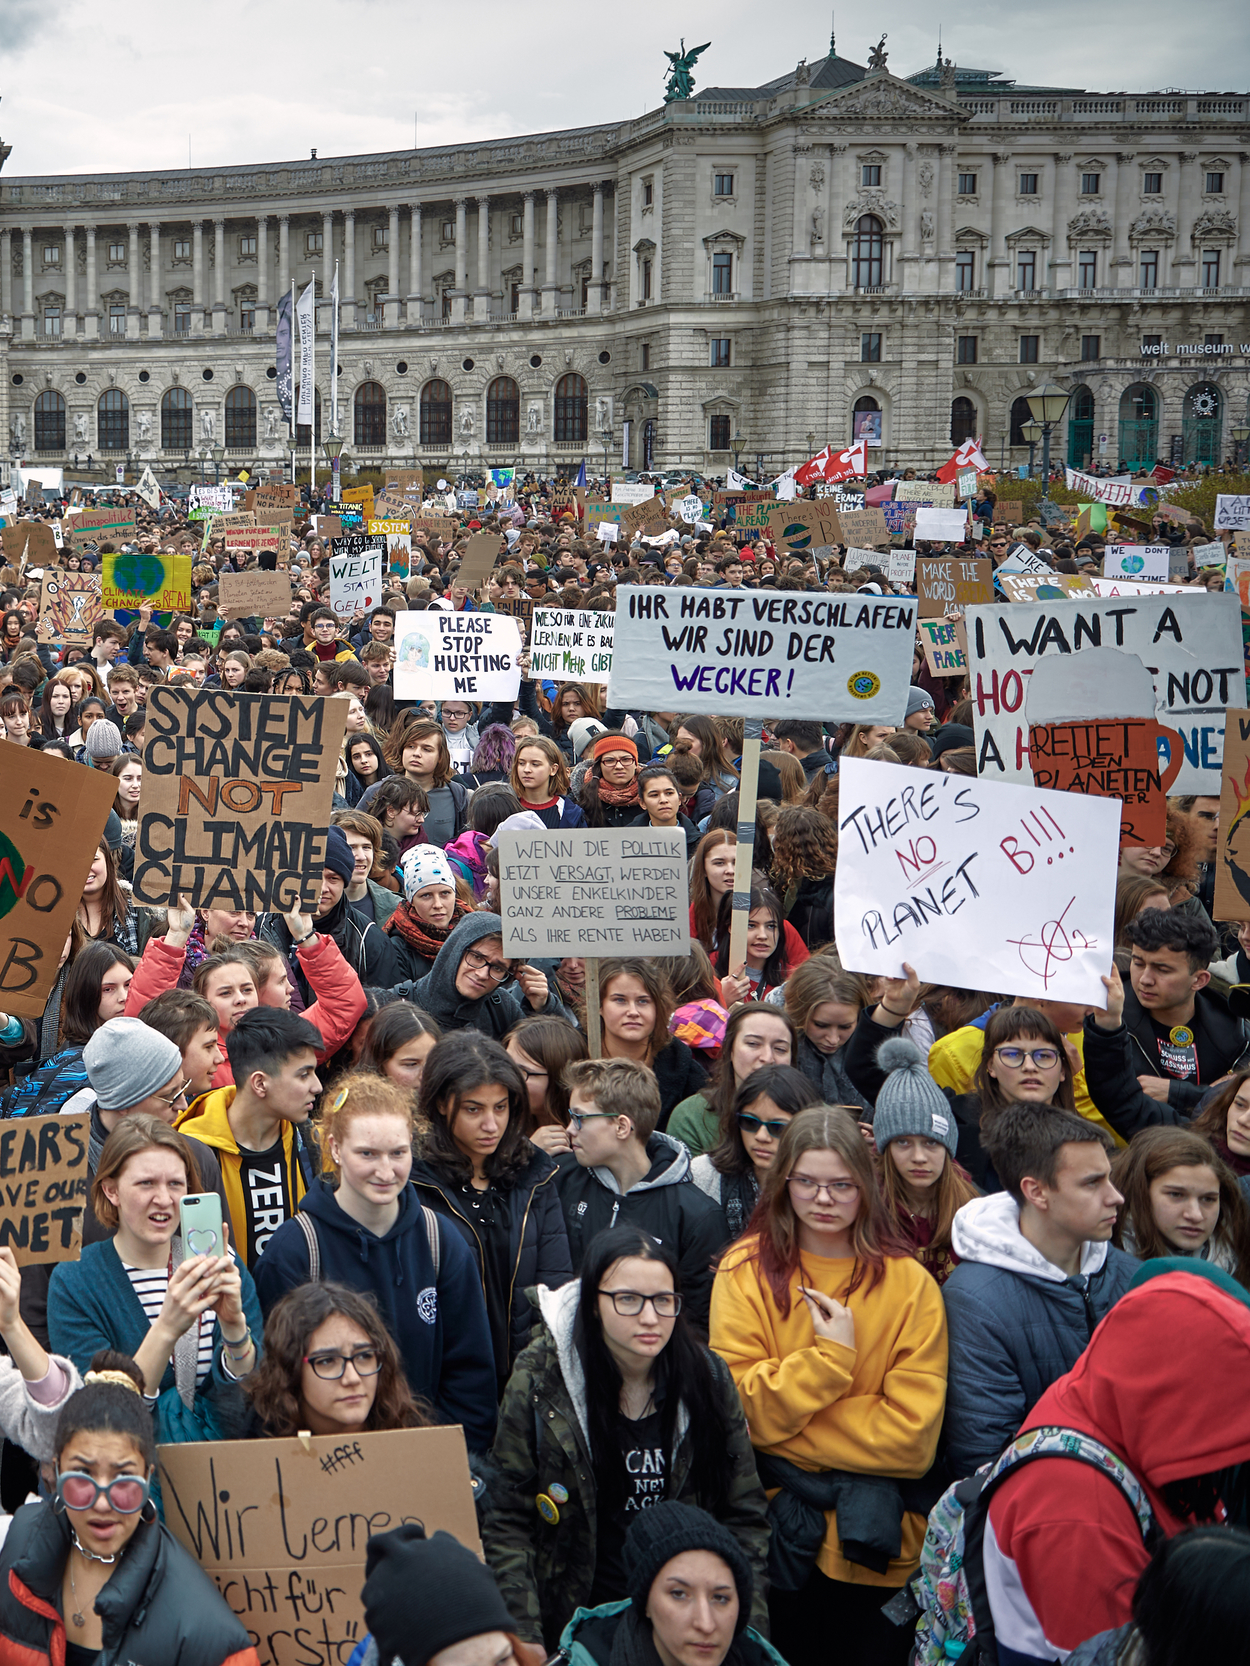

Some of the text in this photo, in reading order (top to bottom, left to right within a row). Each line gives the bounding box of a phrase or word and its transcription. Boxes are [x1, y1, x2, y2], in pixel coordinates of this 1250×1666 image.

[1140, 341, 1169, 354] welt
[1176, 344, 1233, 353] museum
[817, 485, 843, 493] KEINE
[1095, 481, 1133, 503] WITH
[339, 503, 363, 511] TITANIC
[737, 504, 754, 515] THE
[777, 502, 830, 523] There's NO
[71, 509, 133, 530] Klimapolitik?
[370, 521, 409, 533] SYSTEM
[334, 537, 352, 546] WHY
[737, 529, 760, 540] THAN
[818, 521, 835, 544] B
[892, 553, 914, 562] PLANET
[1015, 546, 1043, 573] LIKE
[1111, 546, 1170, 554] WE DON'T
[332, 555, 379, 580] WELT
[891, 569, 912, 577] PROFIT
[922, 562, 980, 582] MAKE THE
[103, 587, 146, 598] CLIMATE
[343, 578, 377, 594] STATT
[922, 582, 991, 603] WORLD GRETA
[1002, 576, 1062, 590] THERE
[162, 589, 191, 608] REAL
[334, 596, 372, 613] GELD
[1012, 589, 1030, 601] IS
[629, 594, 914, 630] IHR HABT VERSCHLAFEN
[439, 616, 493, 633] PLEASE
[921, 621, 958, 645] THERE
[975, 607, 1183, 659] I WANT A
[442, 636, 483, 655] STOP
[587, 635, 596, 647] ES
[661, 625, 835, 663] WIR SIND DER
[434, 654, 511, 673] HURTING
[532, 652, 561, 671] NICHT
[562, 650, 586, 676] MEHR
[454, 677, 478, 694] ME
[671, 663, 795, 698] WECKER!
[1167, 668, 1241, 707] NOT
[148, 686, 325, 746] SYSTEM
[1030, 722, 1146, 758] RETTET
[144, 735, 323, 783] CHANGE
[978, 729, 1005, 774] A
[1070, 755, 1123, 770] DEN
[1034, 768, 1162, 793] PLANETEN
[177, 774, 303, 817] NOT
[18, 787, 61, 830] is
[840, 776, 981, 855] THERE'S
[140, 812, 329, 871] CLIMATE
[515, 840, 681, 859] WENN DIE POLITIK
[895, 835, 937, 882] NO
[502, 865, 680, 883] JETZT VERSAGT, WERDEN
[133, 860, 323, 914] CHANGE
[513, 886, 677, 900] UNSERE ENKELKINDER
[861, 852, 980, 950] PLANET
[507, 905, 678, 919] GANZ ANDERE PROBLEME
[510, 927, 681, 942] ALS IHRE RENTE HABEN
[1161, 1050, 1186, 1062] SCHLUSS
[44, 1177, 87, 1204] OUR
[319, 1442, 364, 1476] #fff
[159, 1456, 259, 1562] Wir
[285, 1571, 347, 1622] für
